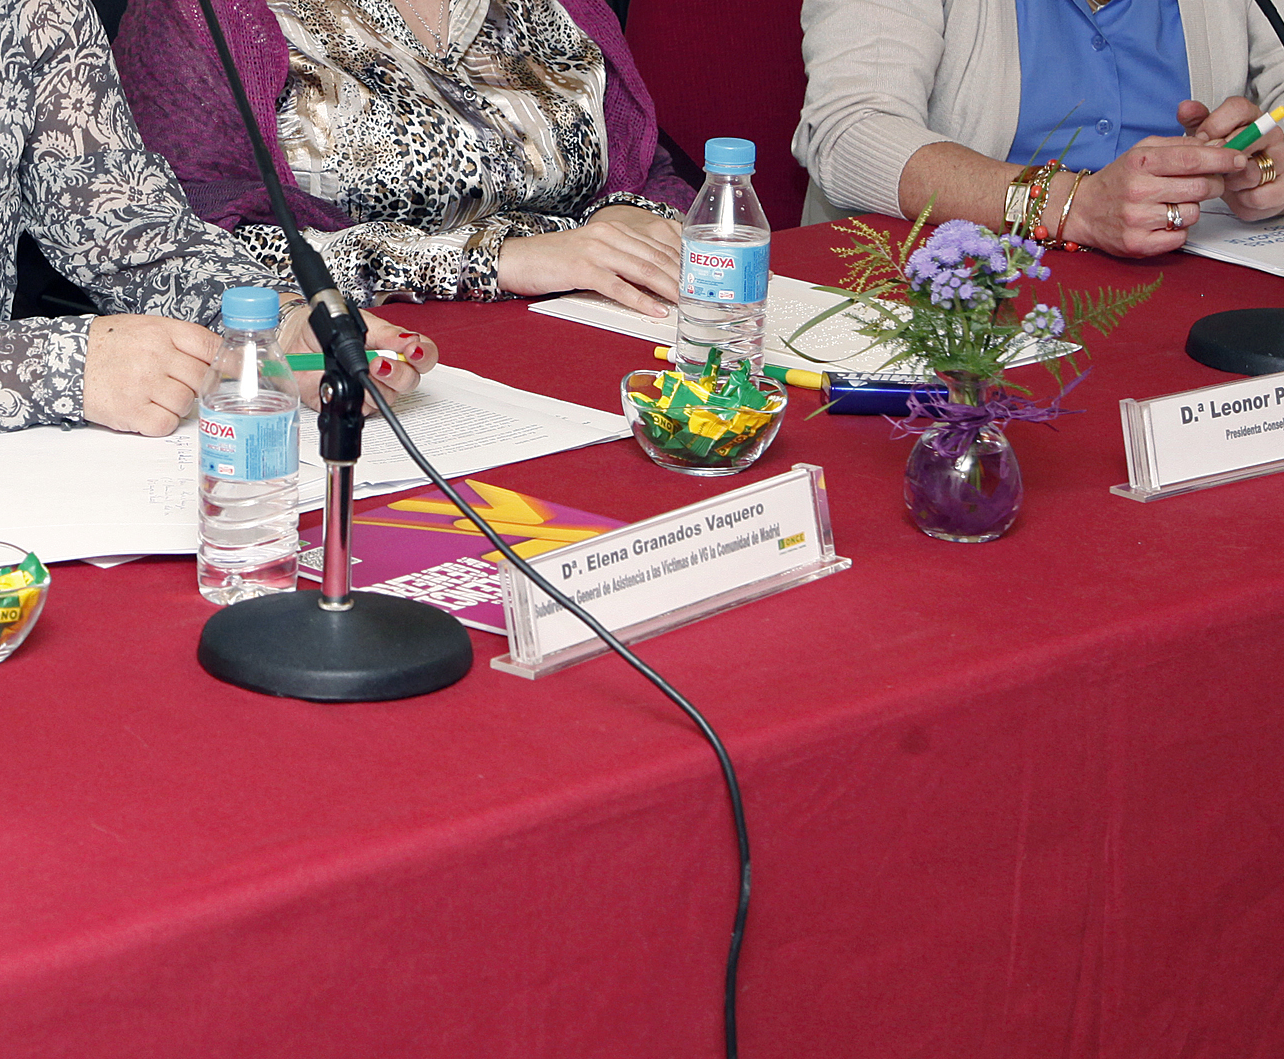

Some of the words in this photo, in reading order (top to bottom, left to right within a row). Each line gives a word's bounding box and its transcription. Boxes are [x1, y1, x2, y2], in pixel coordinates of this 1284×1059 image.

[689, 252, 735, 269] BEZOYA
[1210, 393, 1270, 419] Leonor
[1226, 422, 1262, 440] Presidenta
[586, 547, 628, 572] Elena
[632, 523, 702, 556] Granados
[705, 503, 764, 531] Vaquero
[784, 532, 806, 547] ONCE
[576, 583, 601, 605] General
[602, 581, 611, 596] de
[612, 569, 646, 593] Asistencia
[651, 564, 662, 580] las
[690, 551, 698, 566] de
[699, 547, 708, 563] VG
[709, 545, 717, 559] la
[717, 532, 751, 557] Comunidad
[751, 531, 759, 546] de
[759, 522, 781, 542] Madrid
